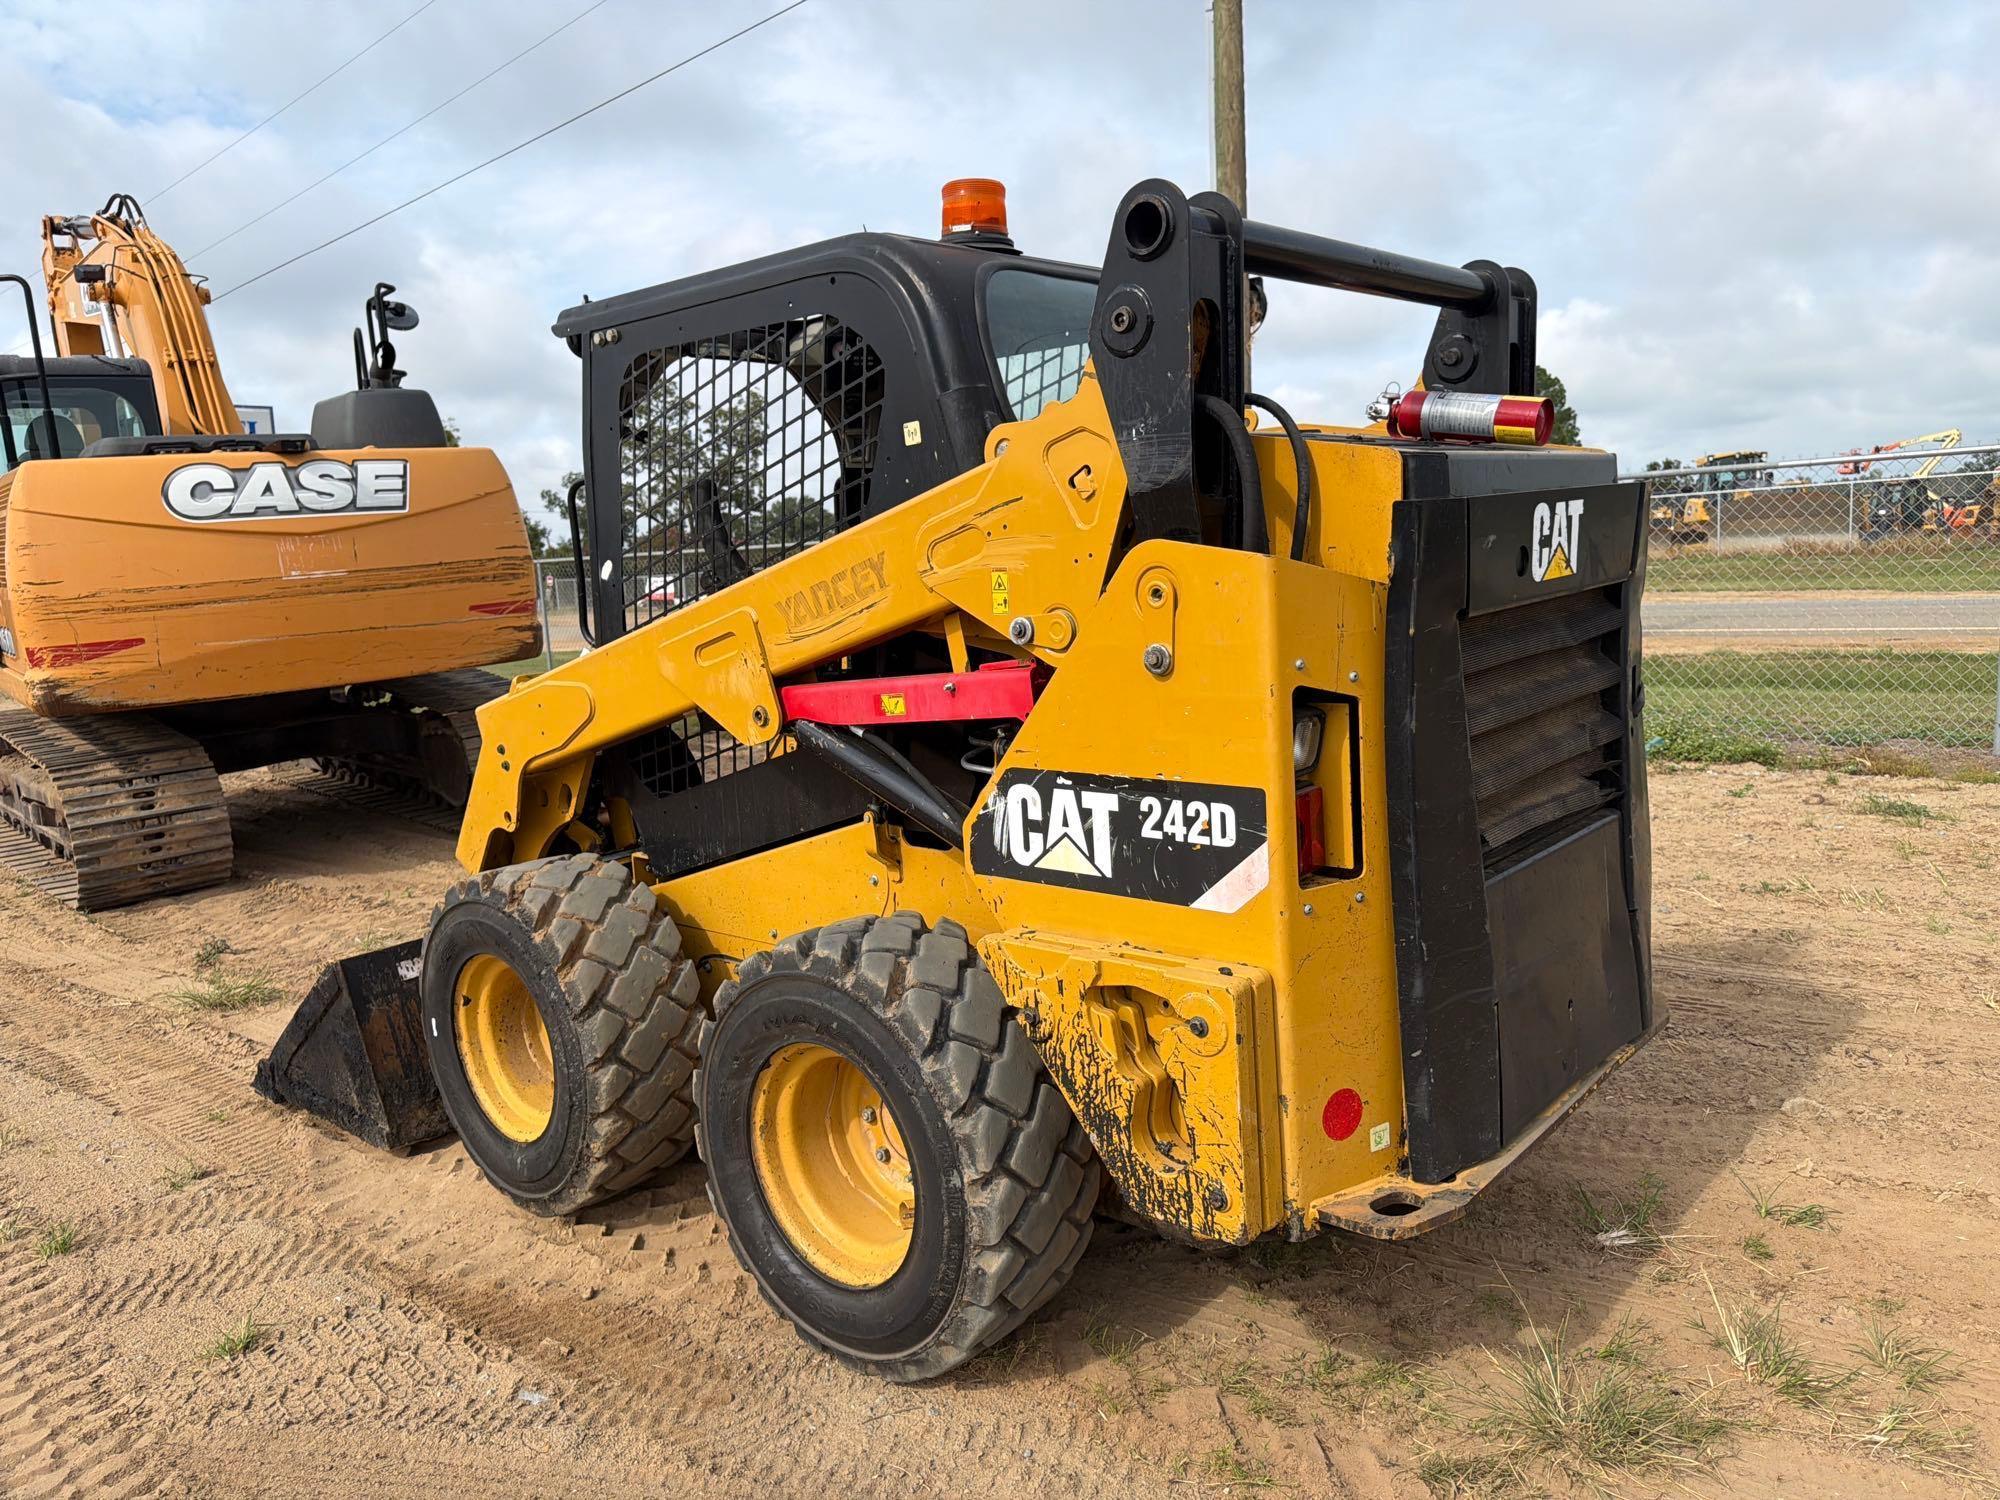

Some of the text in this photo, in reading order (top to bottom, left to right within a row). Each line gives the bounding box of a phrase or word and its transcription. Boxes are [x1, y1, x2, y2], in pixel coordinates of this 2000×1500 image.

[167, 460, 405, 518] CASE
[1532, 499, 1584, 582] CAT
[774, 551, 888, 632] YANCEY
[1007, 783, 1237, 878] CAT 242D
